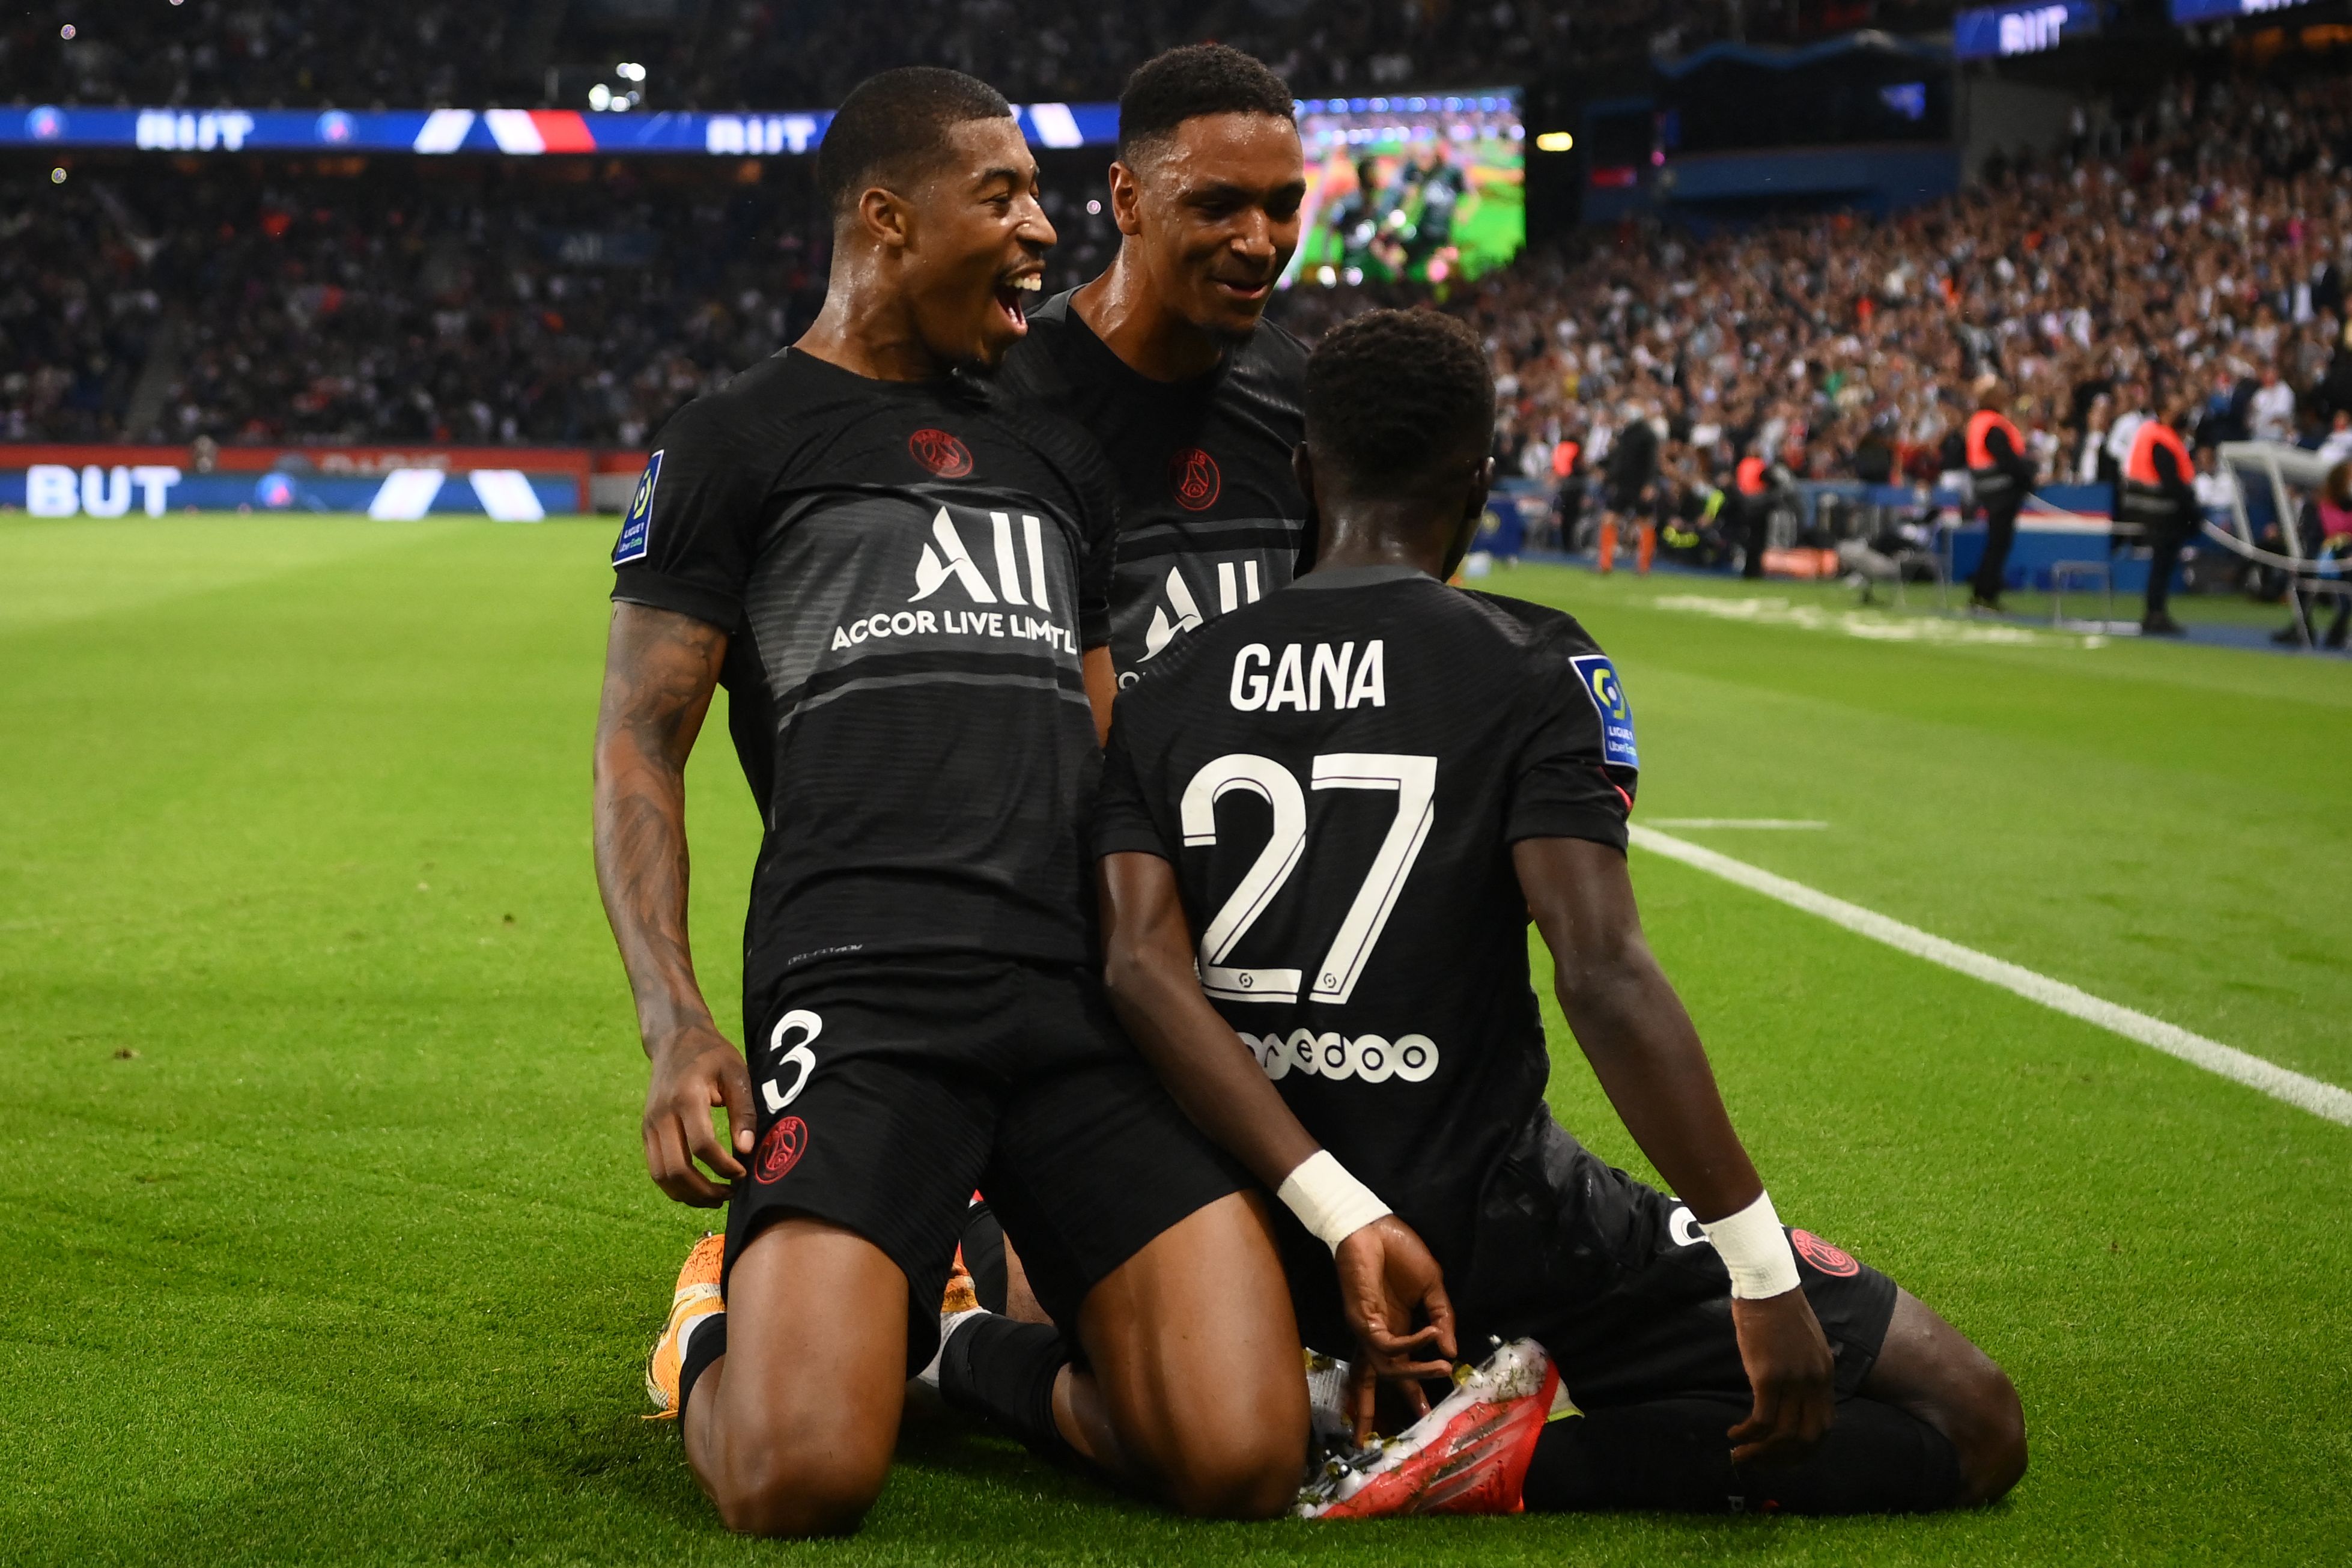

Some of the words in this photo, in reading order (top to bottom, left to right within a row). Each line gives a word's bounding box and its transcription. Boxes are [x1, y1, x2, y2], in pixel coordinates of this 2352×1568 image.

[26, 465, 180, 519] BUT
[831, 610, 939, 651] ACCOR
[944, 610, 1004, 637] LIVE
[1229, 639, 1386, 711] GANA
[1181, 753, 1438, 1004] 27
[762, 1009, 822, 1114] 3
